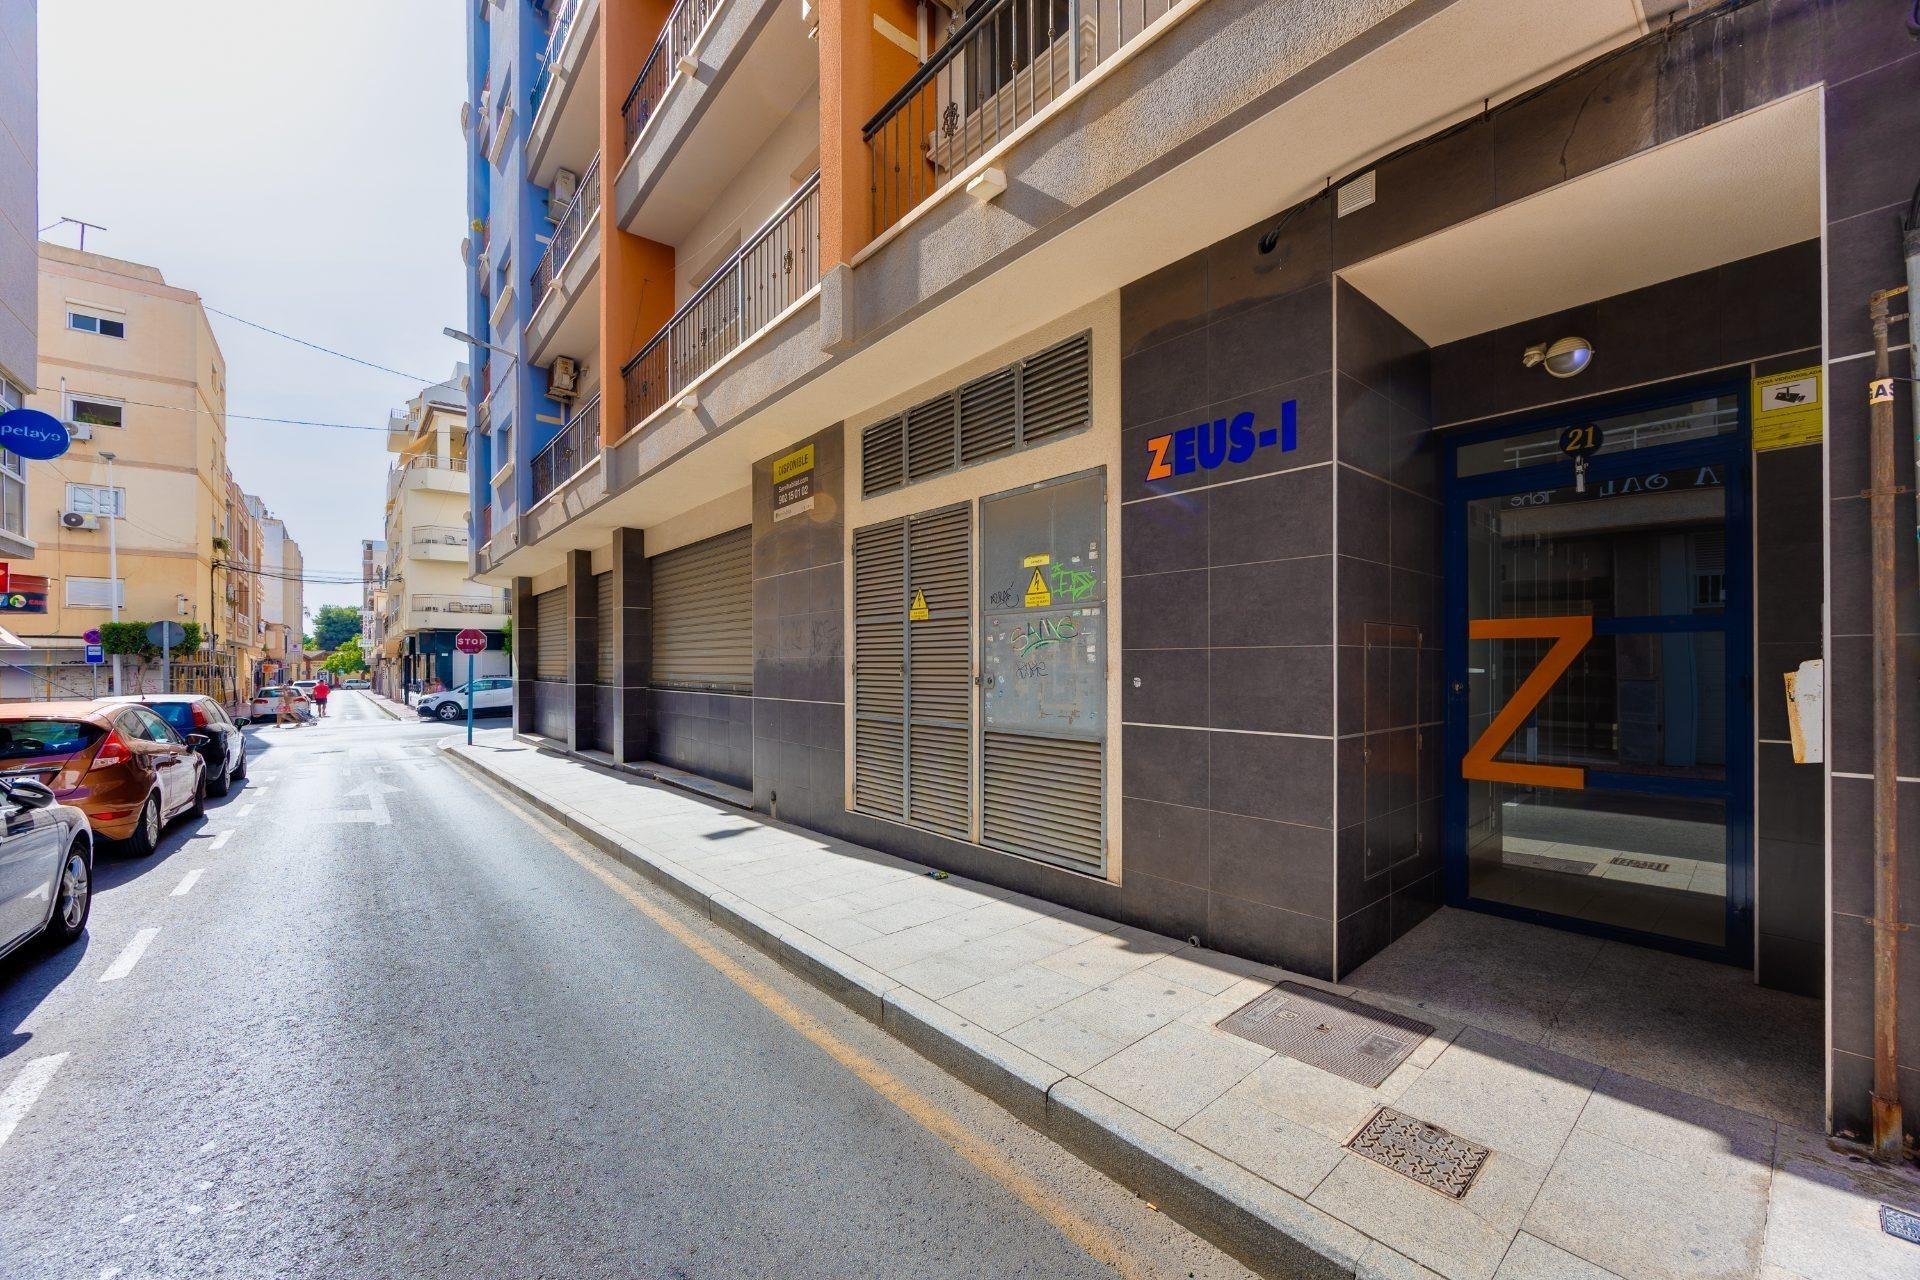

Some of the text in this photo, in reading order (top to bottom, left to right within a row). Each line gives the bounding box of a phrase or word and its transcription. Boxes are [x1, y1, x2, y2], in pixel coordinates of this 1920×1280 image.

[1869, 383, 1895, 400] AS
[0, 425, 61, 442] pelayo
[1565, 426, 1595, 452] 21
[778, 453, 809, 476] DISPONIBLE
[788, 490, 795, 500] 15
